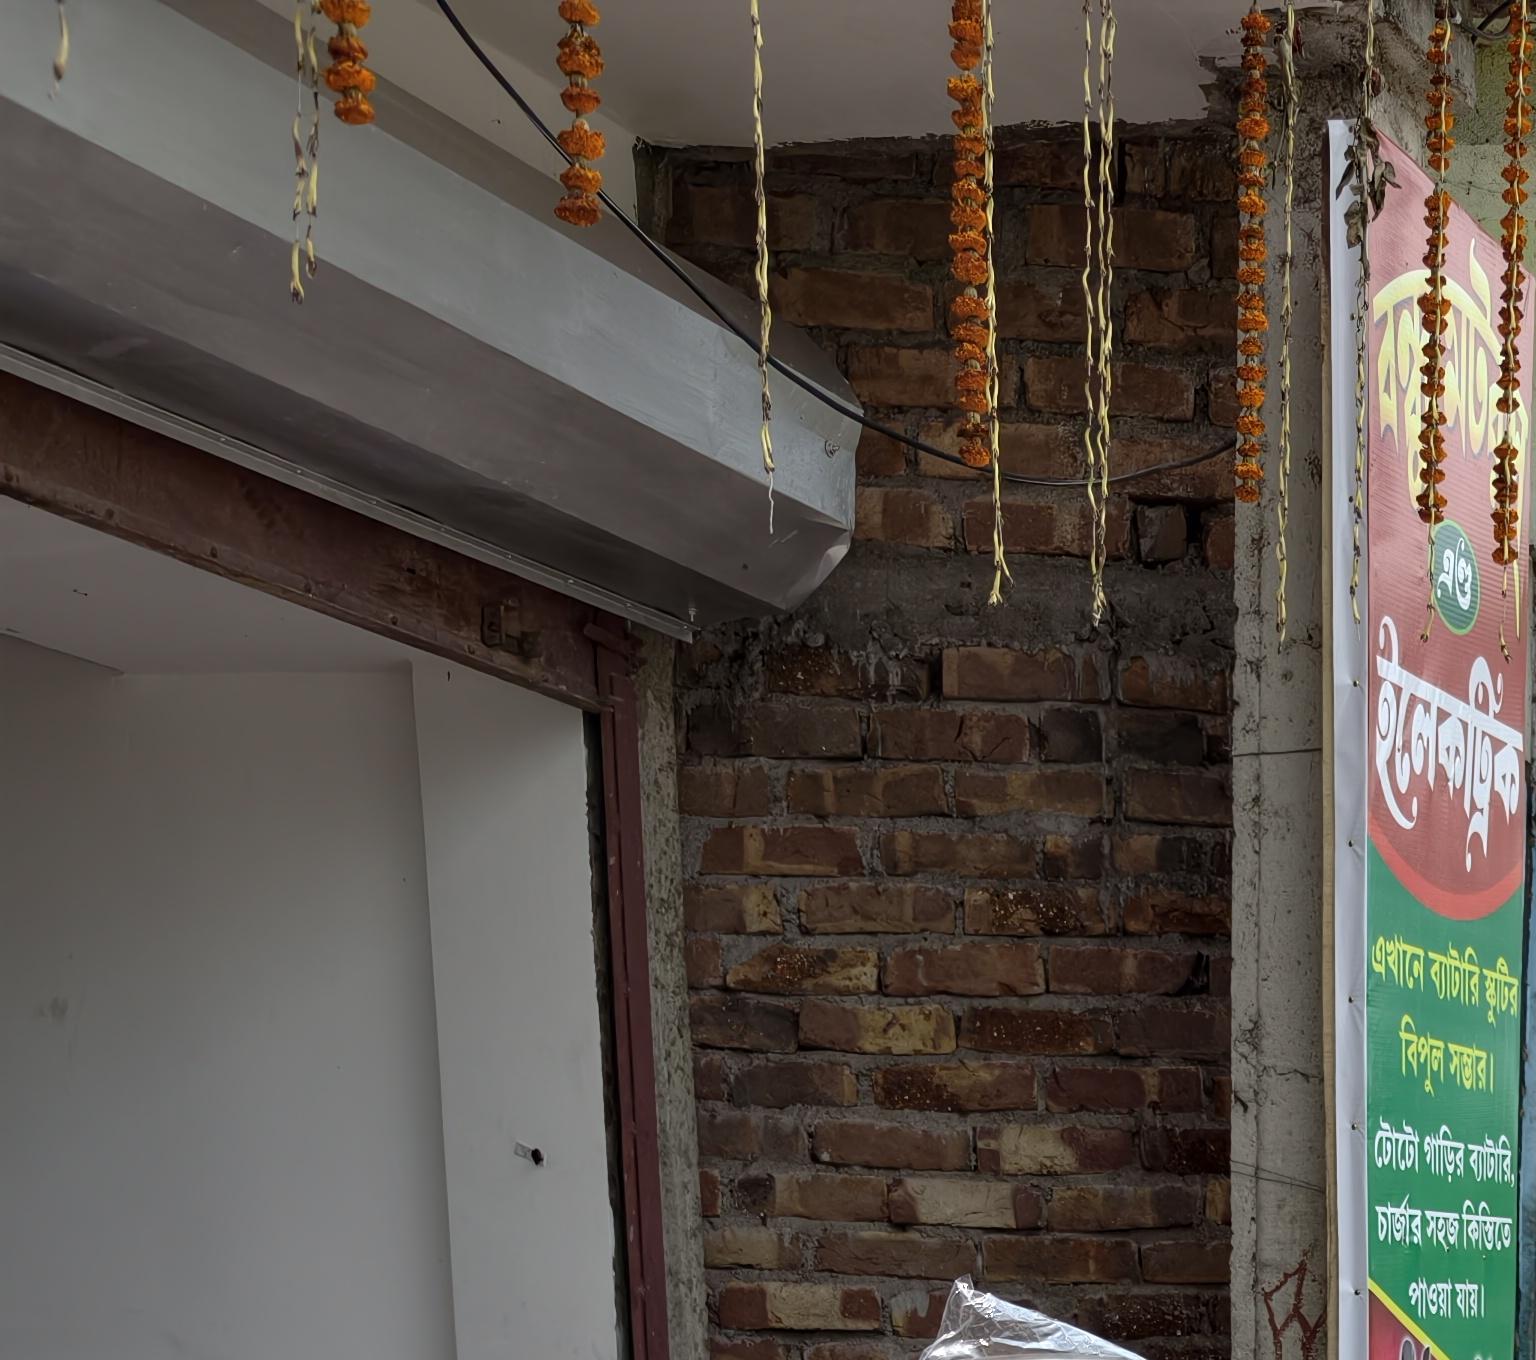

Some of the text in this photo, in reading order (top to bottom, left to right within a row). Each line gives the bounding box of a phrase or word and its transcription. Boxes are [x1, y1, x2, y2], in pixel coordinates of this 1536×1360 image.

[1375, 615, 1524, 873] ইলেকট্রিক
[1371, 935, 1519, 1031] এখানে ব্যাটারি স্কুটির
[1399, 1015, 1445, 1097] বিপুল
[1374, 1116, 1420, 1174] টোটো
[1423, 1124, 1465, 1184] গাড়ির
[1375, 1196, 1513, 1253] চার্জার সহজ কিস্তিতে
[1408, 1277, 1453, 1322] পাওয়া
